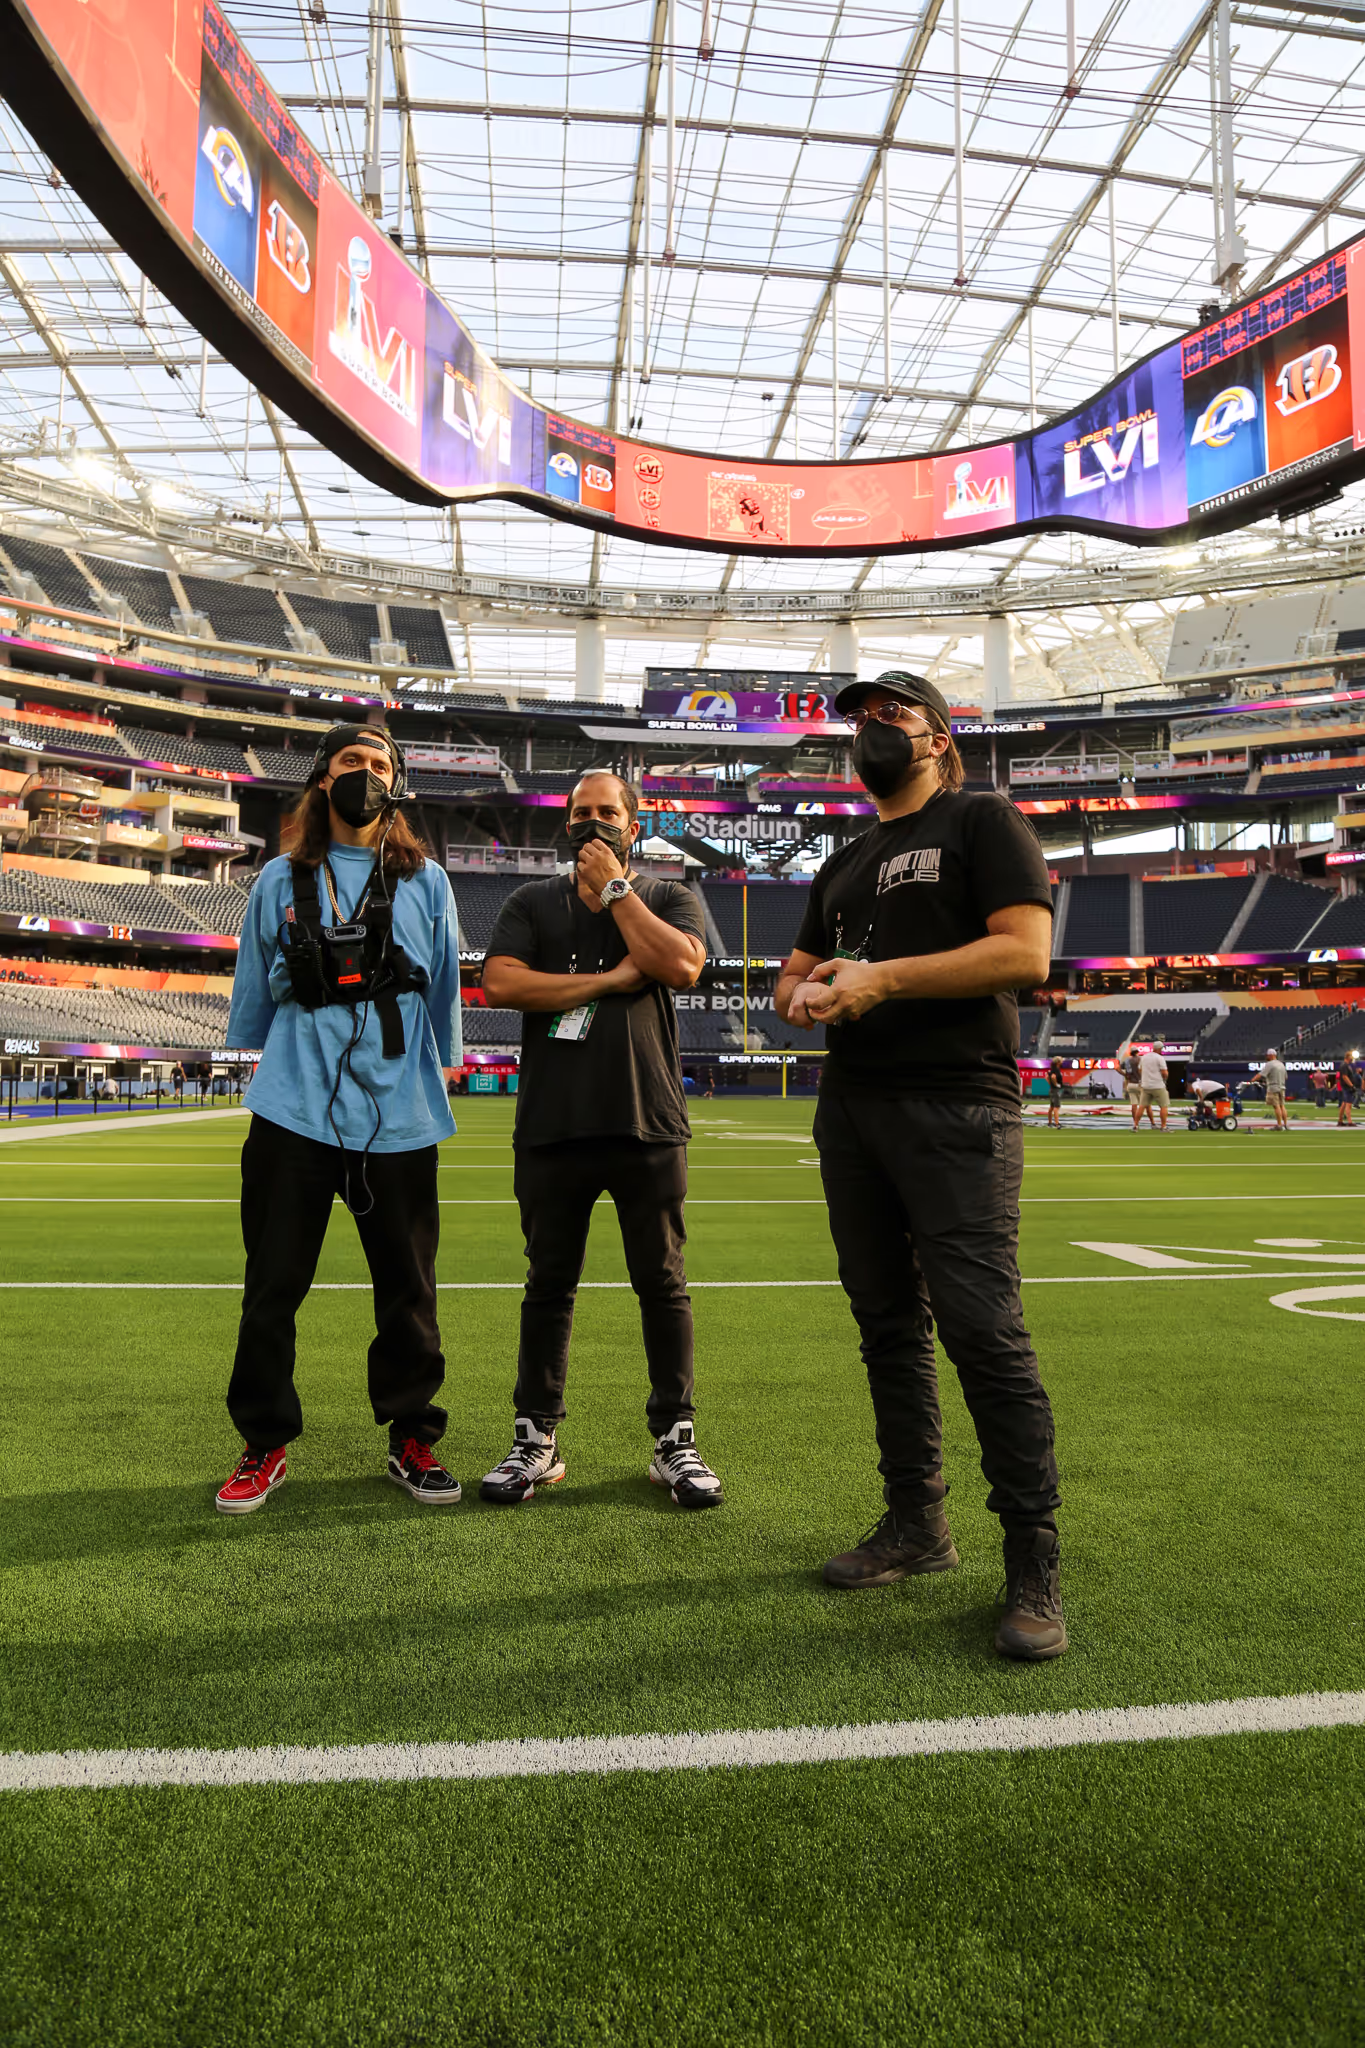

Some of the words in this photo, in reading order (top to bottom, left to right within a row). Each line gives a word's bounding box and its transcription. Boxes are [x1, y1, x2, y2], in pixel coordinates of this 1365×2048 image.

[201, 246, 224, 278] SUPER
[224, 273, 243, 300] BOWL
[444, 360, 478, 397] SUPER
[442, 372, 512, 466] LVI
[1063, 425, 1113, 453] SUPER
[1115, 408, 1158, 433] BOWL
[1063, 416, 1159, 498] LVI
[639, 462, 659, 475] LVI
[1199, 496, 1226, 513] SUPER
[1228, 486, 1250, 502] BOWL
[1253, 478, 1267, 491] LVI
[413, 701, 446, 713] BENGALS
[675, 691, 737, 718] LA
[752, 705, 762, 714] AT
[648, 720, 686, 730] SUPER
[686, 721, 720, 731] BOWL
[720, 723, 738, 732] LVI
[957, 724, 983, 734] LOS
[984, 722, 1046, 734] ANGELES
[8, 736, 44, 751] BENGALS
[757, 804, 782, 813] RAMS
[688, 812, 802, 840] Stadium
[187, 837, 206, 847] LOS
[206, 840, 246, 852] ANGELES
[1326, 854, 1355, 864] SUPER
[718, 959, 744, 967] 0:00
[750, 959, 765, 967] 25
[4, 1038, 40, 1055] BENGALS
[211, 1051, 239, 1062] SUPER
[718, 1056, 751, 1064] SUPER
[752, 1056, 782, 1064] BOWL
[1285, 1062, 1315, 1071] BOWL
[1315, 1061, 1334, 1071] LVI
